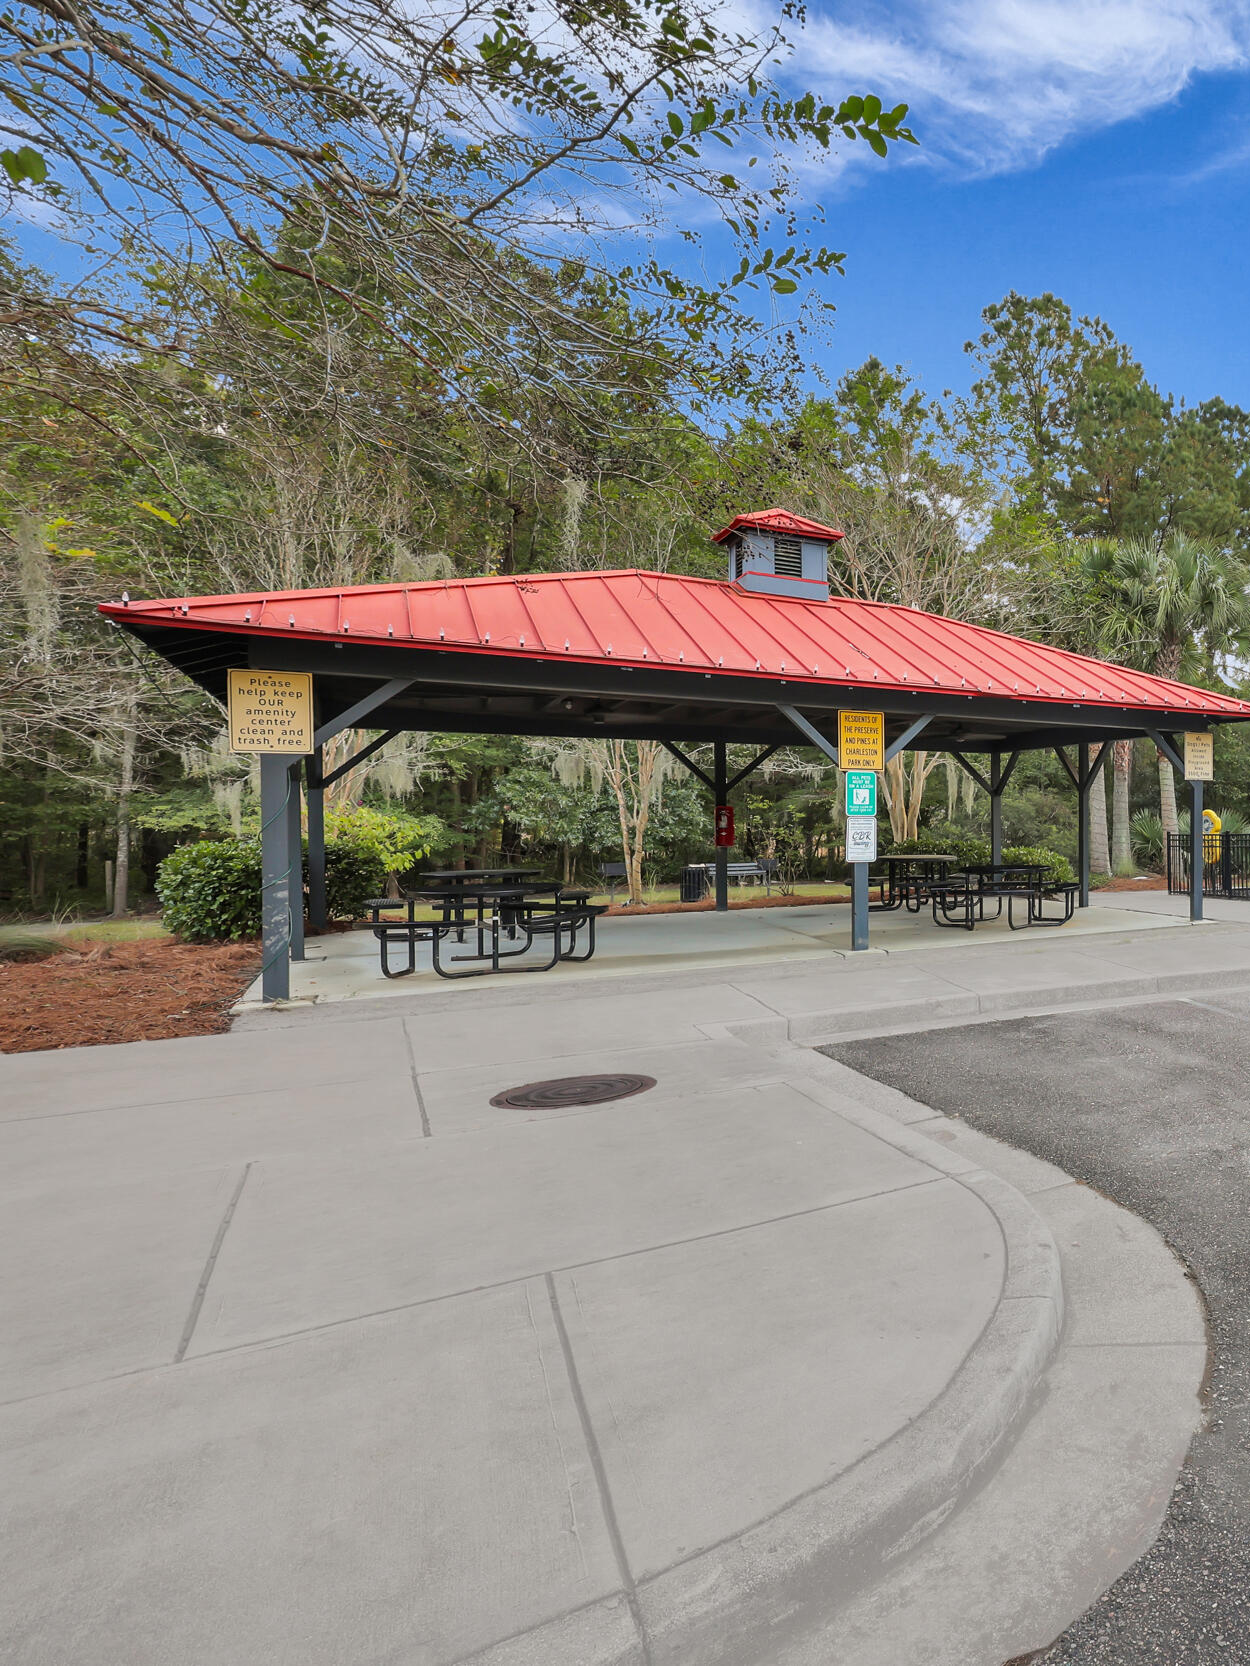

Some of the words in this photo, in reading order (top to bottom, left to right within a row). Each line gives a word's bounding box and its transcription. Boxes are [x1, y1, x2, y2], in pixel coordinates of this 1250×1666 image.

[250, 678, 291, 687] Please
[238, 688, 266, 697] help
[274, 689, 302, 699] keep
[246, 708, 296, 718] amenity
[844, 715, 870, 723] RESIDENTS
[240, 727, 274, 735] clean
[854, 726, 879, 734] PRESERVE
[278, 738, 306, 746] free.
